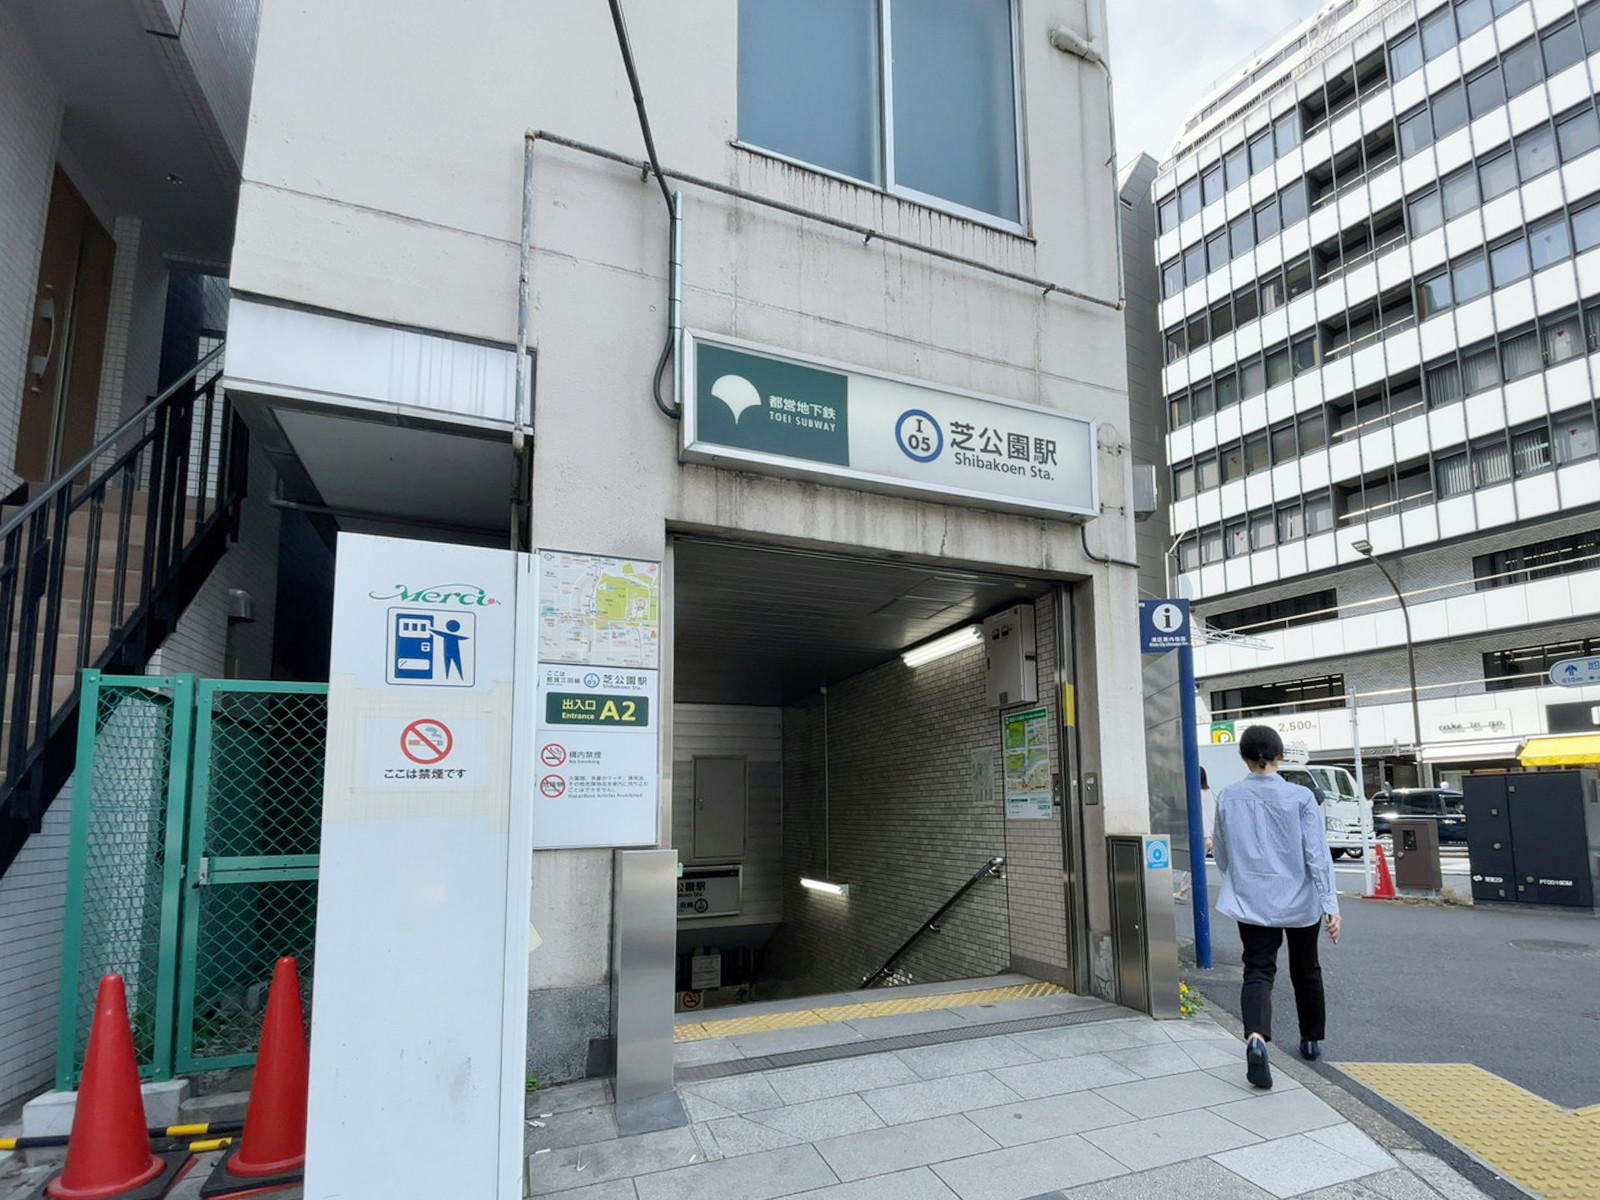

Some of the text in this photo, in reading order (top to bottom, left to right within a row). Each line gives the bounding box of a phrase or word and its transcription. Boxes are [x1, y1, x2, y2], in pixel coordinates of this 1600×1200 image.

[768, 394, 836, 420] 都営地下鉄
[768, 411, 836, 432] TOEI SUBWAY
[907, 435, 930, 452] 05
[949, 420, 1057, 467] 芝公園駅
[954, 451, 1055, 481] Shibakoen Sta.
[368, 584, 490, 606] Merci
[603, 674, 647, 686] 芝公園駅
[562, 699, 596, 711] 出入口
[599, 700, 636, 721] A2
[562, 712, 595, 720] Entrance
[569, 751, 602, 759] 構内禁煙
[383, 768, 467, 780] ここは禁煙です
